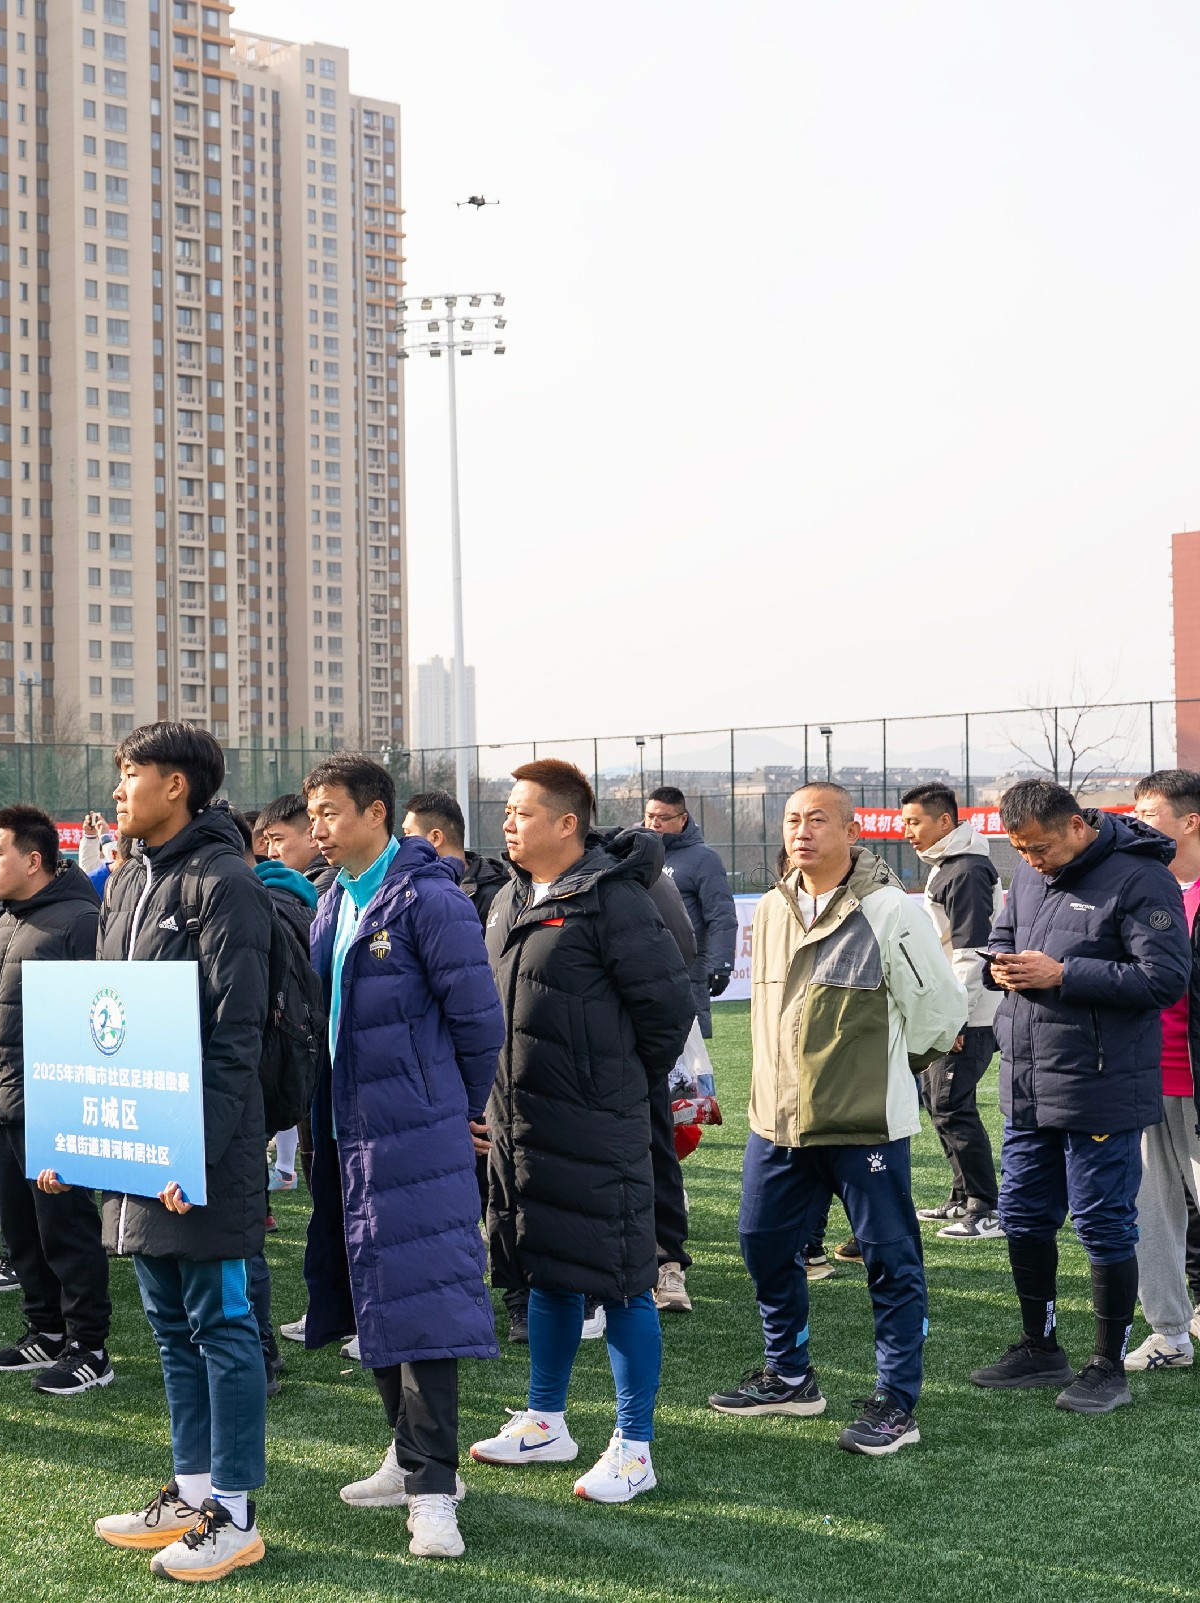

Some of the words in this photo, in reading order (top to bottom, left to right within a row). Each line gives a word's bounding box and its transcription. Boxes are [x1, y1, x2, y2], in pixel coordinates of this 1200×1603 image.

[32, 1061, 191, 1093] 2025年济南市社区足球超级赛
[82, 1096, 139, 1131] 历城区
[54, 1132, 170, 1166] 全福街道清河新居社区
